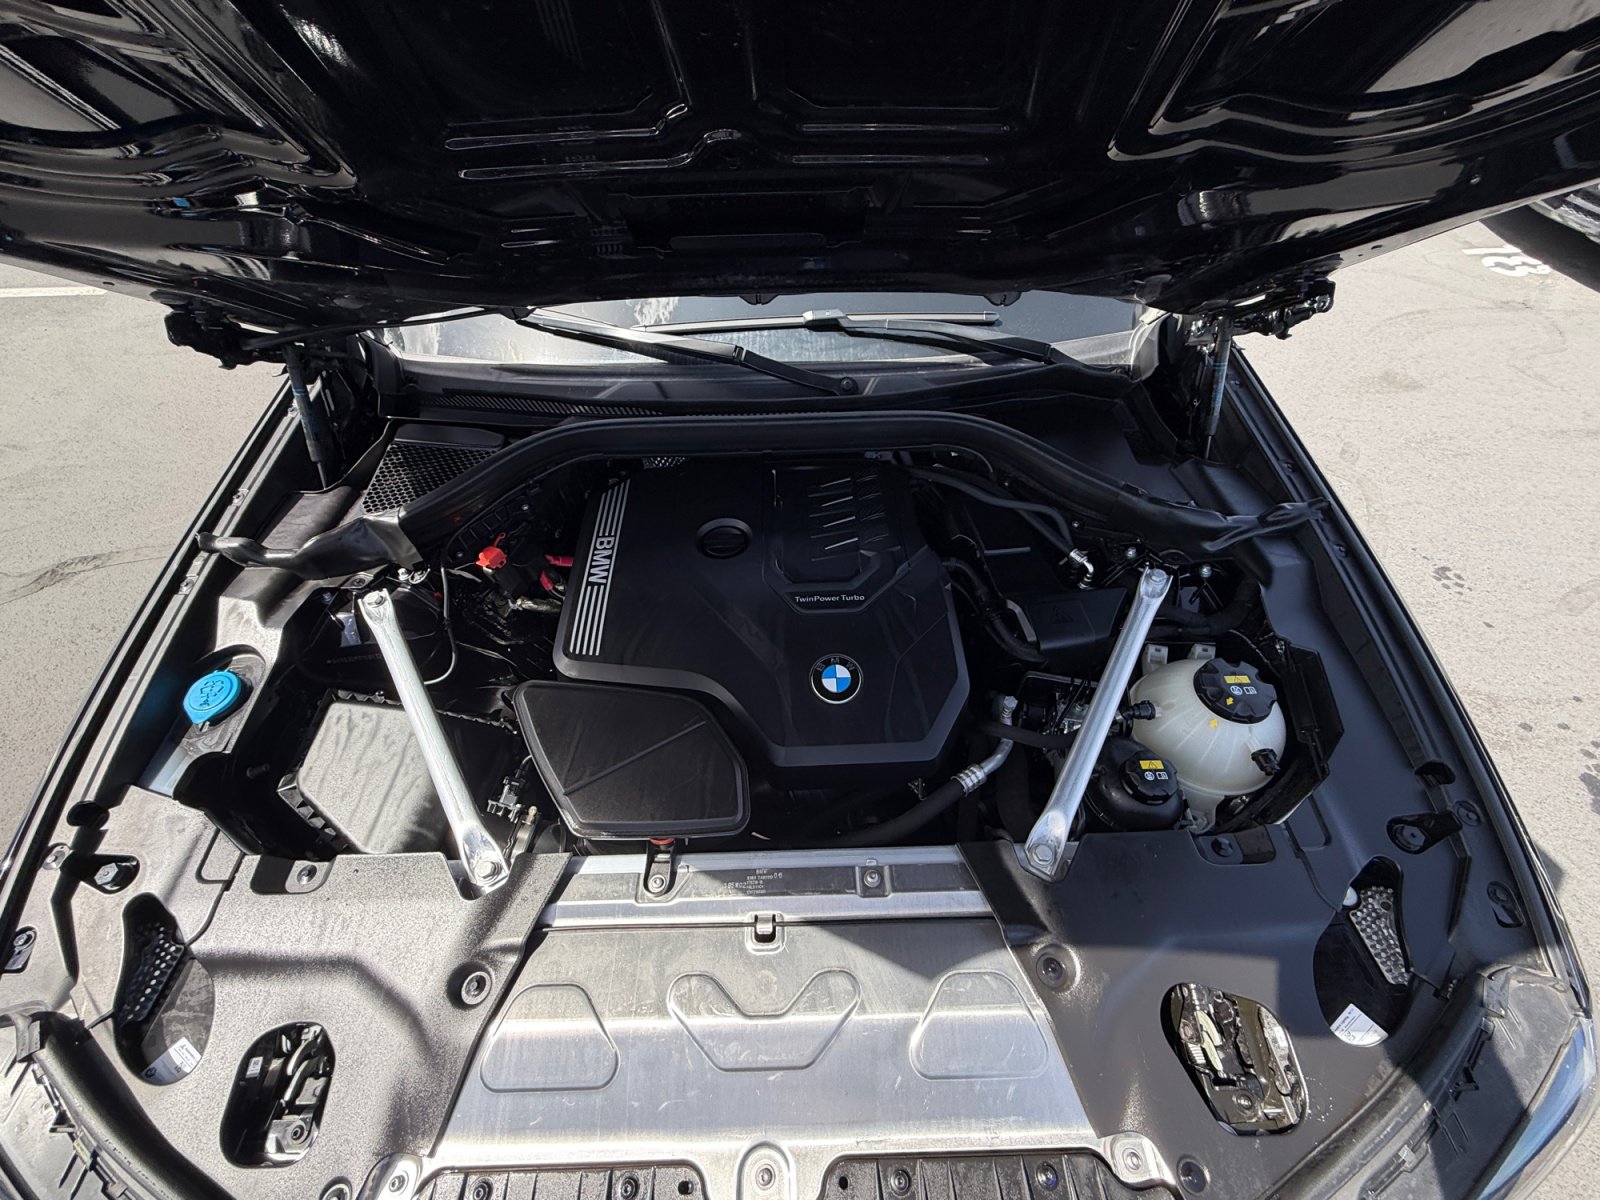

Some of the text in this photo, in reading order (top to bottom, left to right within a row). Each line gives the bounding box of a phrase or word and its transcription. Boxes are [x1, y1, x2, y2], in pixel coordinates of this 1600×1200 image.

[588, 536, 615, 583] BMW
[794, 594, 840, 603] TwinPower
[816, 657, 855, 672] BMW
